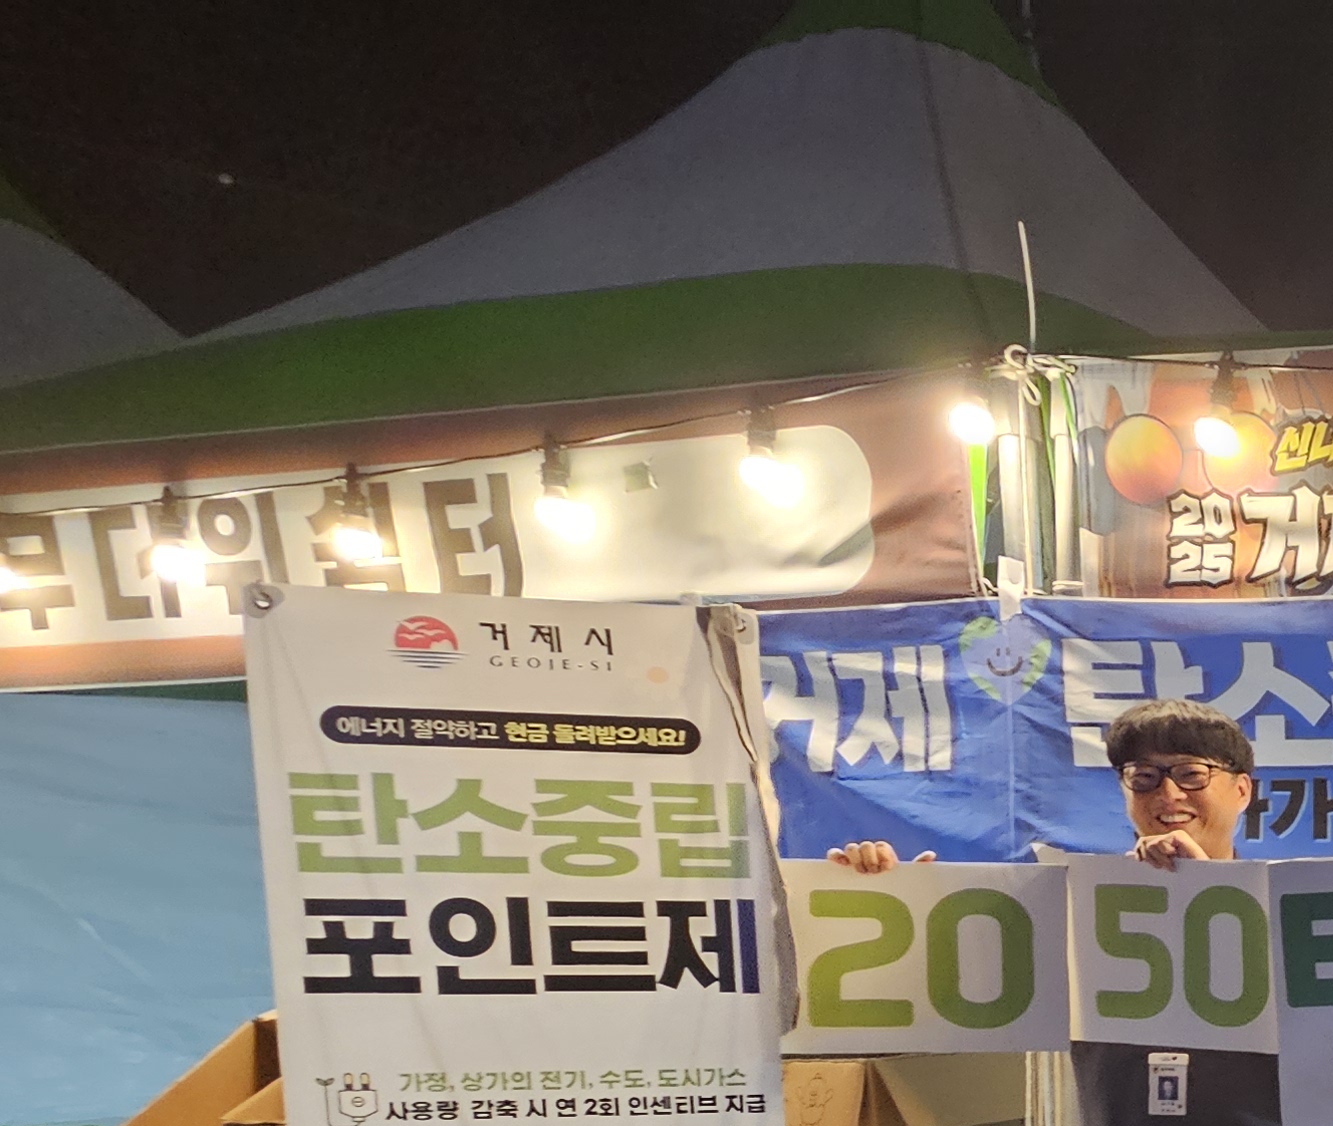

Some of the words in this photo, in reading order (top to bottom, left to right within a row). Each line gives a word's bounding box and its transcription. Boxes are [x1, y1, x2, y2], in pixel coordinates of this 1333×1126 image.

[479, 621, 615, 655] 거제시
[489, 655, 614, 671] GEOJE-SI
[336, 716, 405, 738] 에너지
[410, 718, 500, 740] 절약하고
[504, 720, 549, 743] 현금
[552, 722, 687, 747] 돌려받으세요!
[288, 771, 751, 879] 탄소중립
[303, 896, 761, 996] 포인트제
[400, 1071, 455, 1094] 가정,
[461, 1070, 533, 1092] 상가의
[540, 1069, 594, 1091] 전기,
[599, 1068, 653, 1089] 수도,
[657, 1067, 747, 1088] 도시가스
[385, 1100, 460, 1121] 사용량
[471, 1098, 519, 1120] 감축
[526, 1097, 548, 1118] 시
[556, 1097, 578, 1118] 연
[584, 1097, 620, 1117] 2회
[628, 1095, 719, 1116] 인센티브
[725, 1093, 767, 1114] 지급
